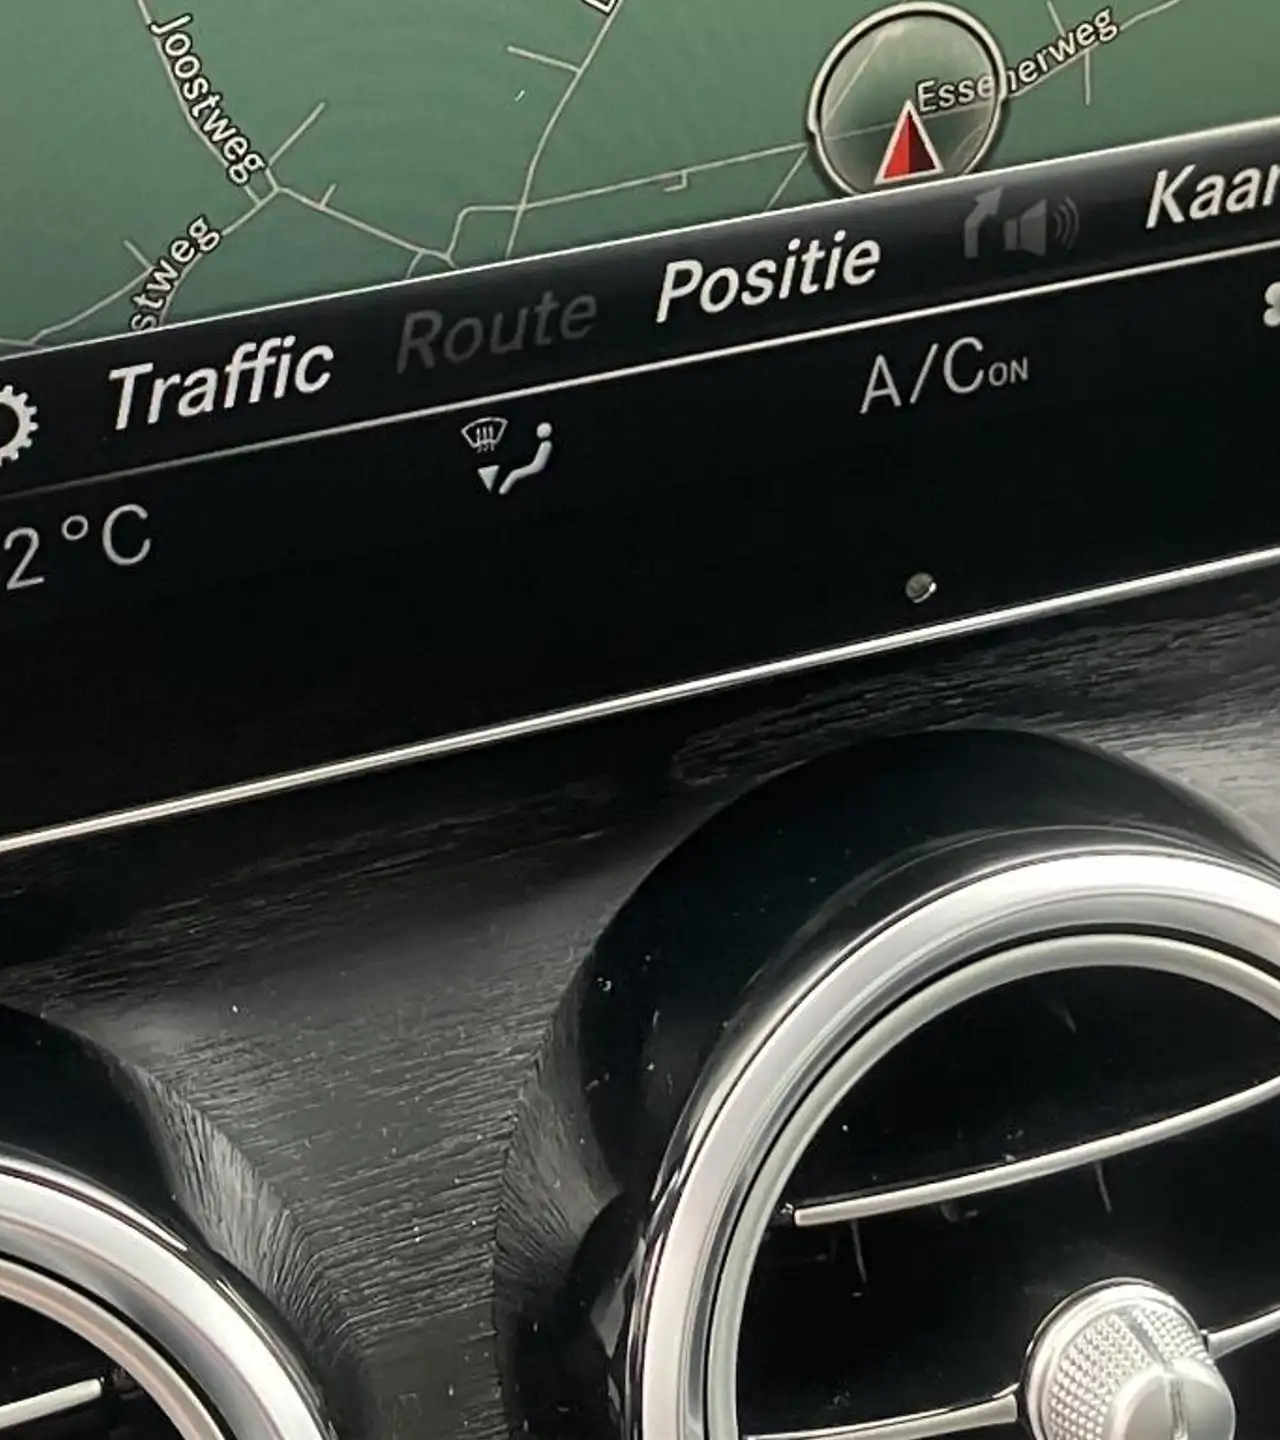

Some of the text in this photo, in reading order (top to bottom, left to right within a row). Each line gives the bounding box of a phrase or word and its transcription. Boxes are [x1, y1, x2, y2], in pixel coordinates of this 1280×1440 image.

[148, 12, 266, 186] Joostweg
[108, 335, 336, 431] Traffic
[395, 290, 598, 375] Route
[655, 231, 883, 324] Positie
